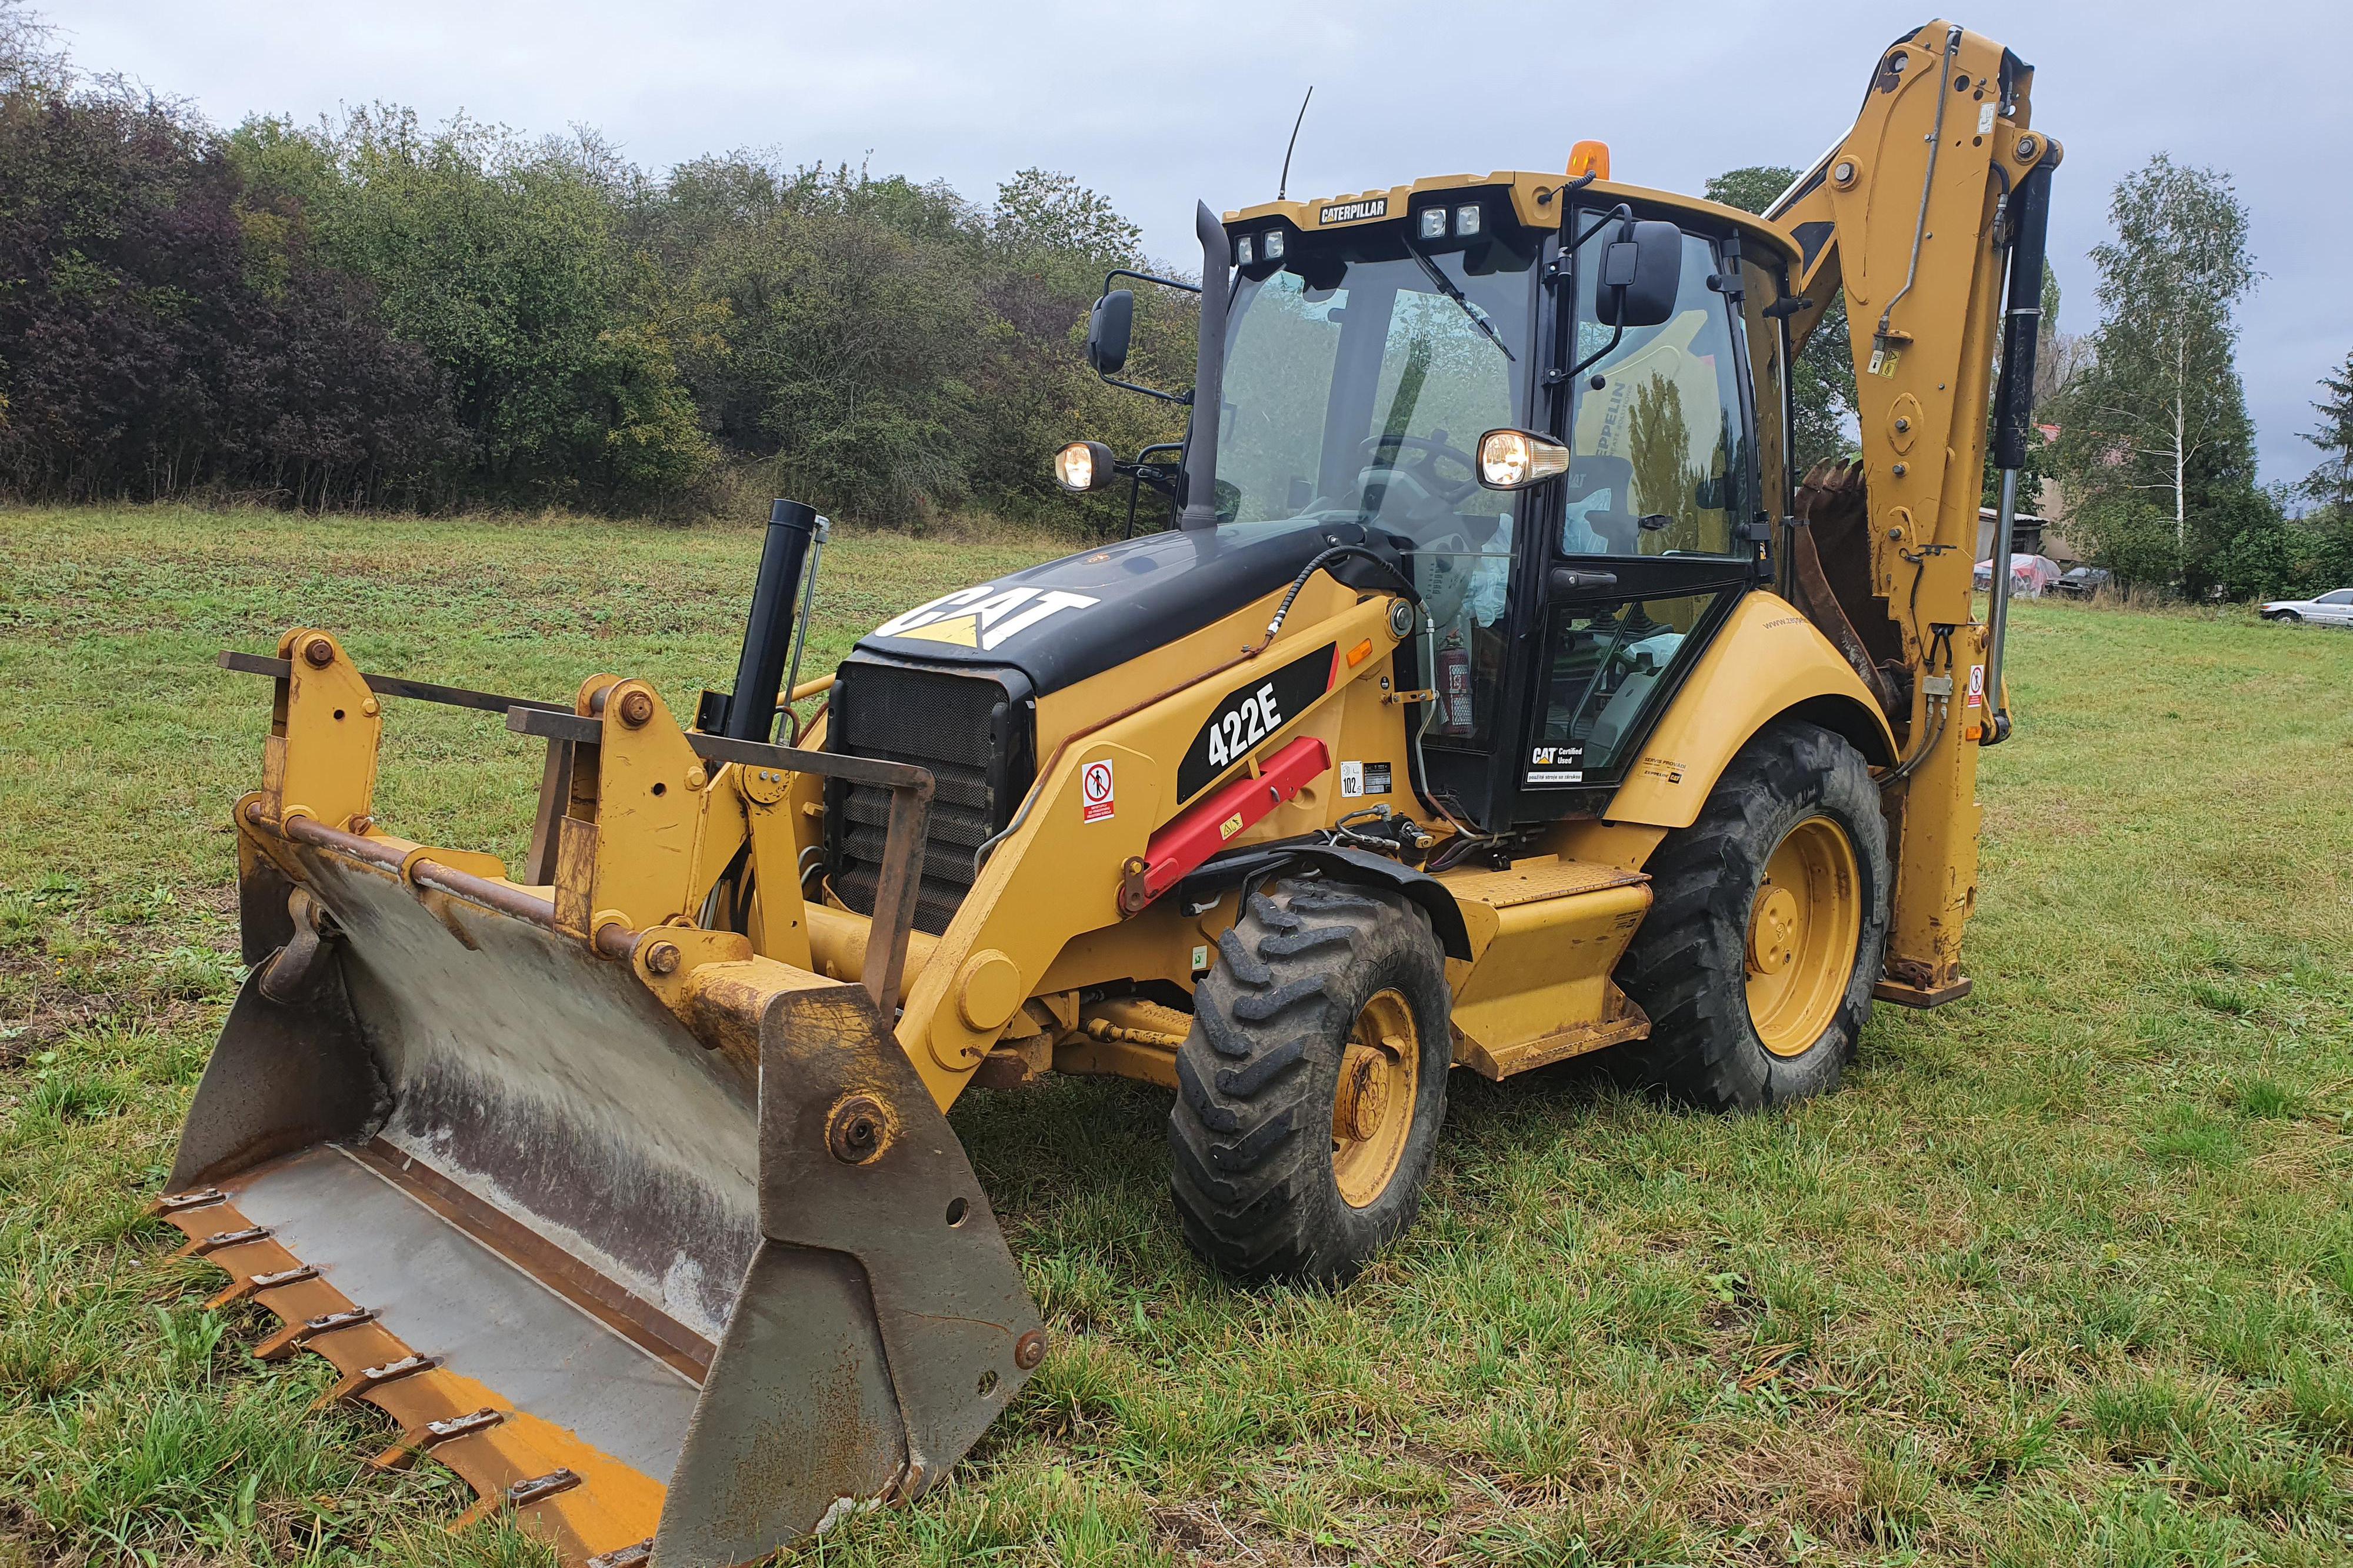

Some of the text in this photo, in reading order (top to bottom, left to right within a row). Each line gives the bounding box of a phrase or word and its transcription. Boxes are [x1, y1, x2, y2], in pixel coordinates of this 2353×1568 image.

[1321, 201, 1384, 223] CATERPILLAR
[875, 586, 1101, 651] CAT
[1209, 682, 1282, 766] 422E
[1532, 748, 1557, 764] CAT
[1344, 778, 1356, 793] 102
